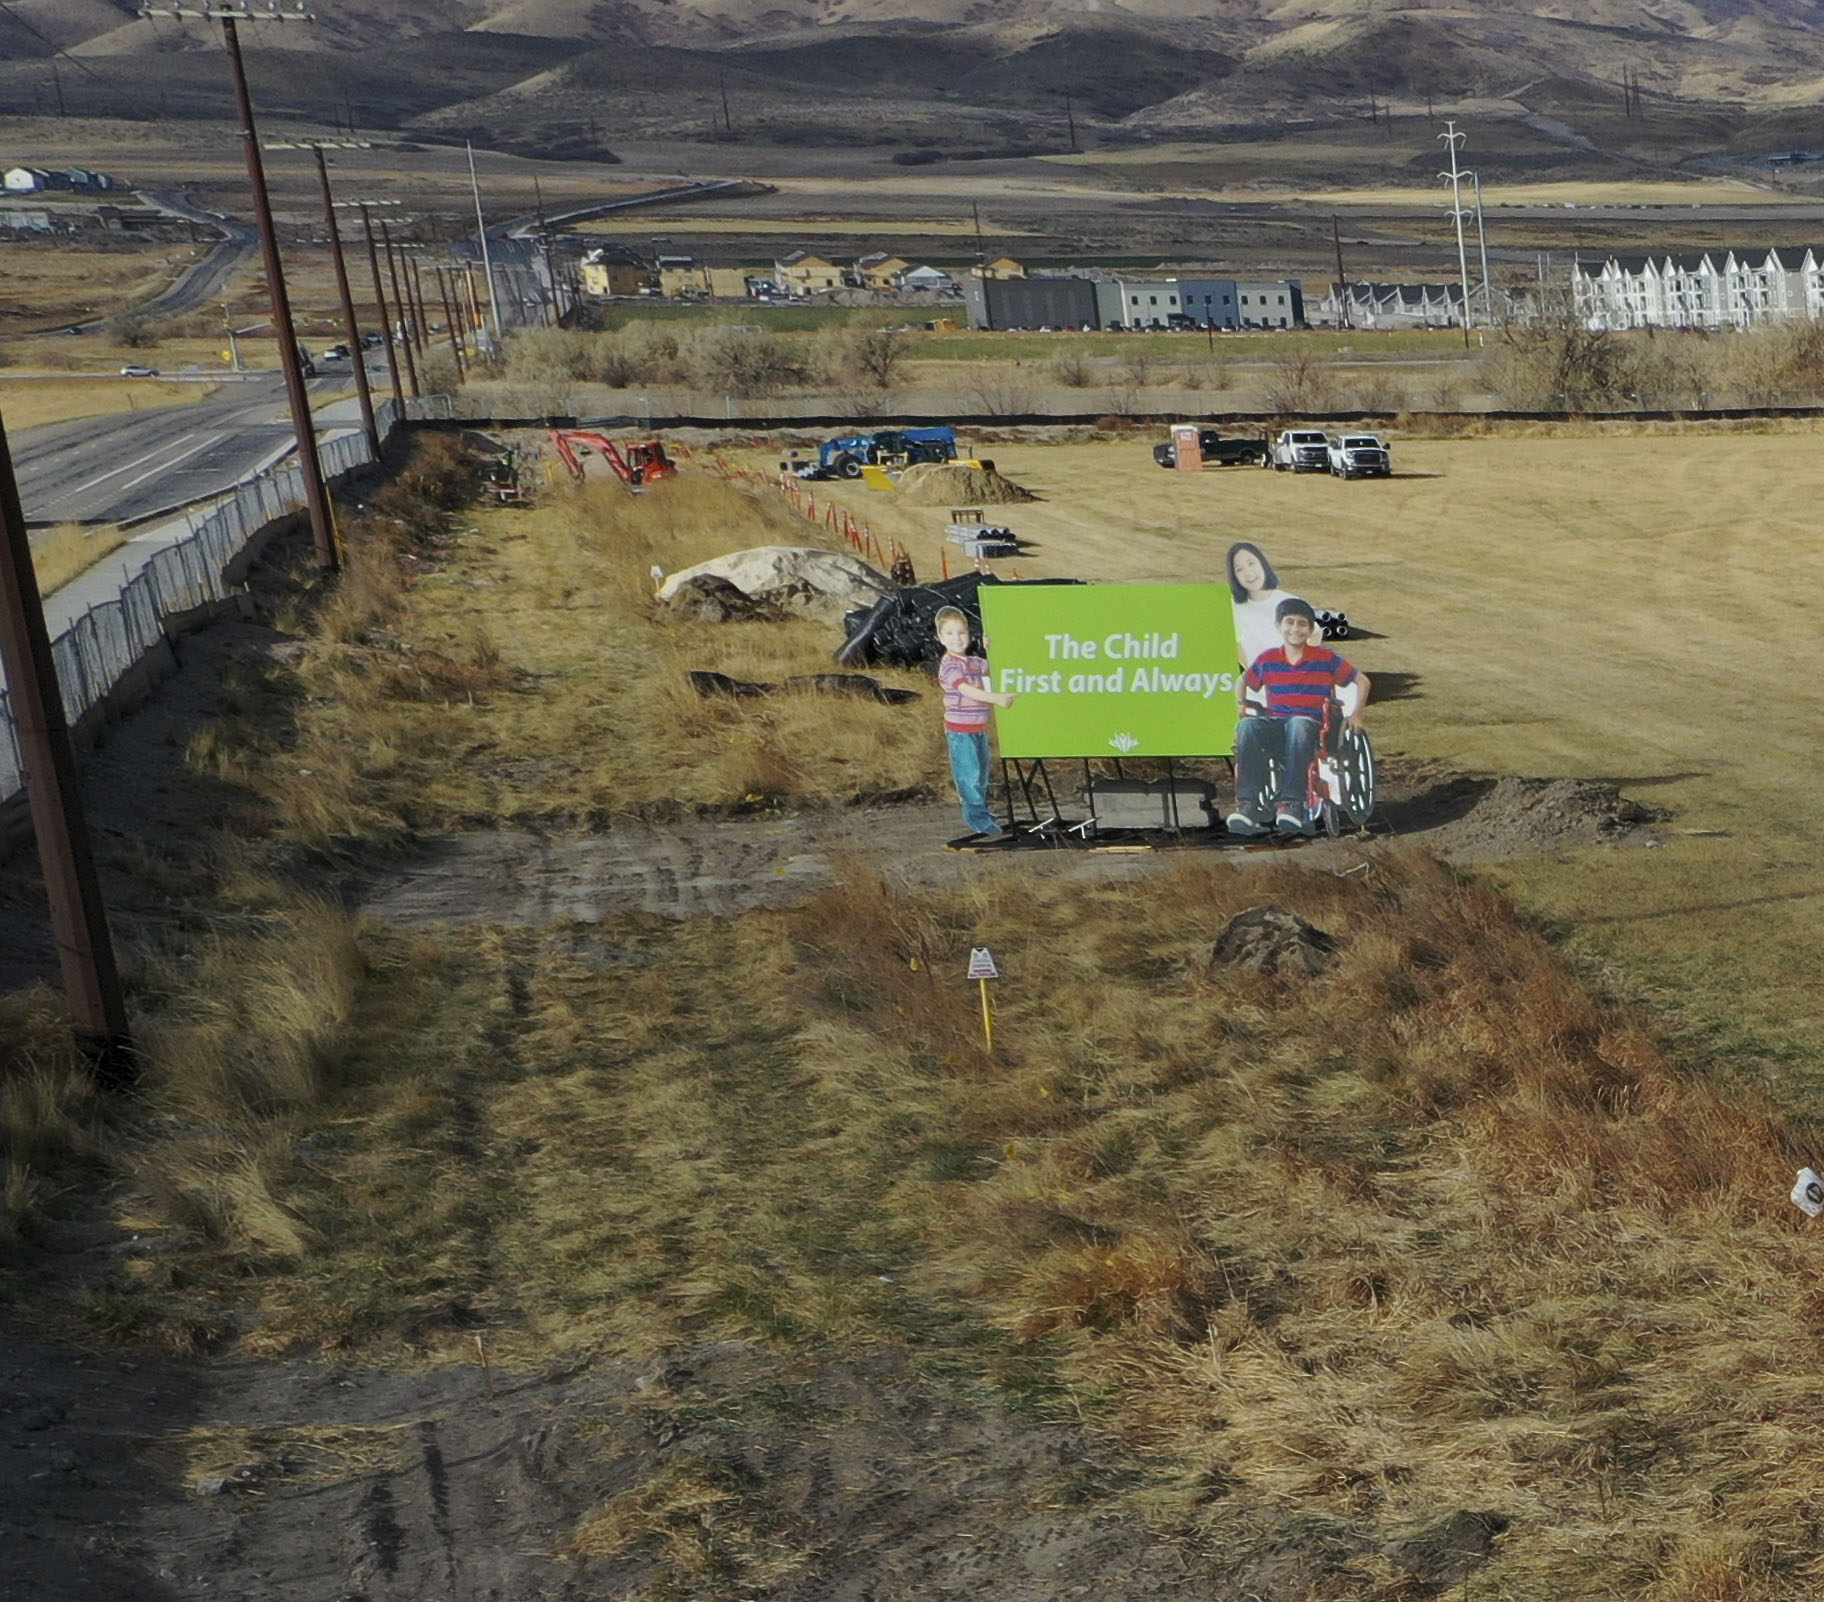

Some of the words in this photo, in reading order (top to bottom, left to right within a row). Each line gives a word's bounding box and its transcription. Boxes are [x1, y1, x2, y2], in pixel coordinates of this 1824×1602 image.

[1045, 633, 1097, 660] The
[1104, 632, 1179, 660] Child
[1001, 668, 1062, 694] First
[1068, 666, 1125, 694] and
[1131, 667, 1234, 700] Always
